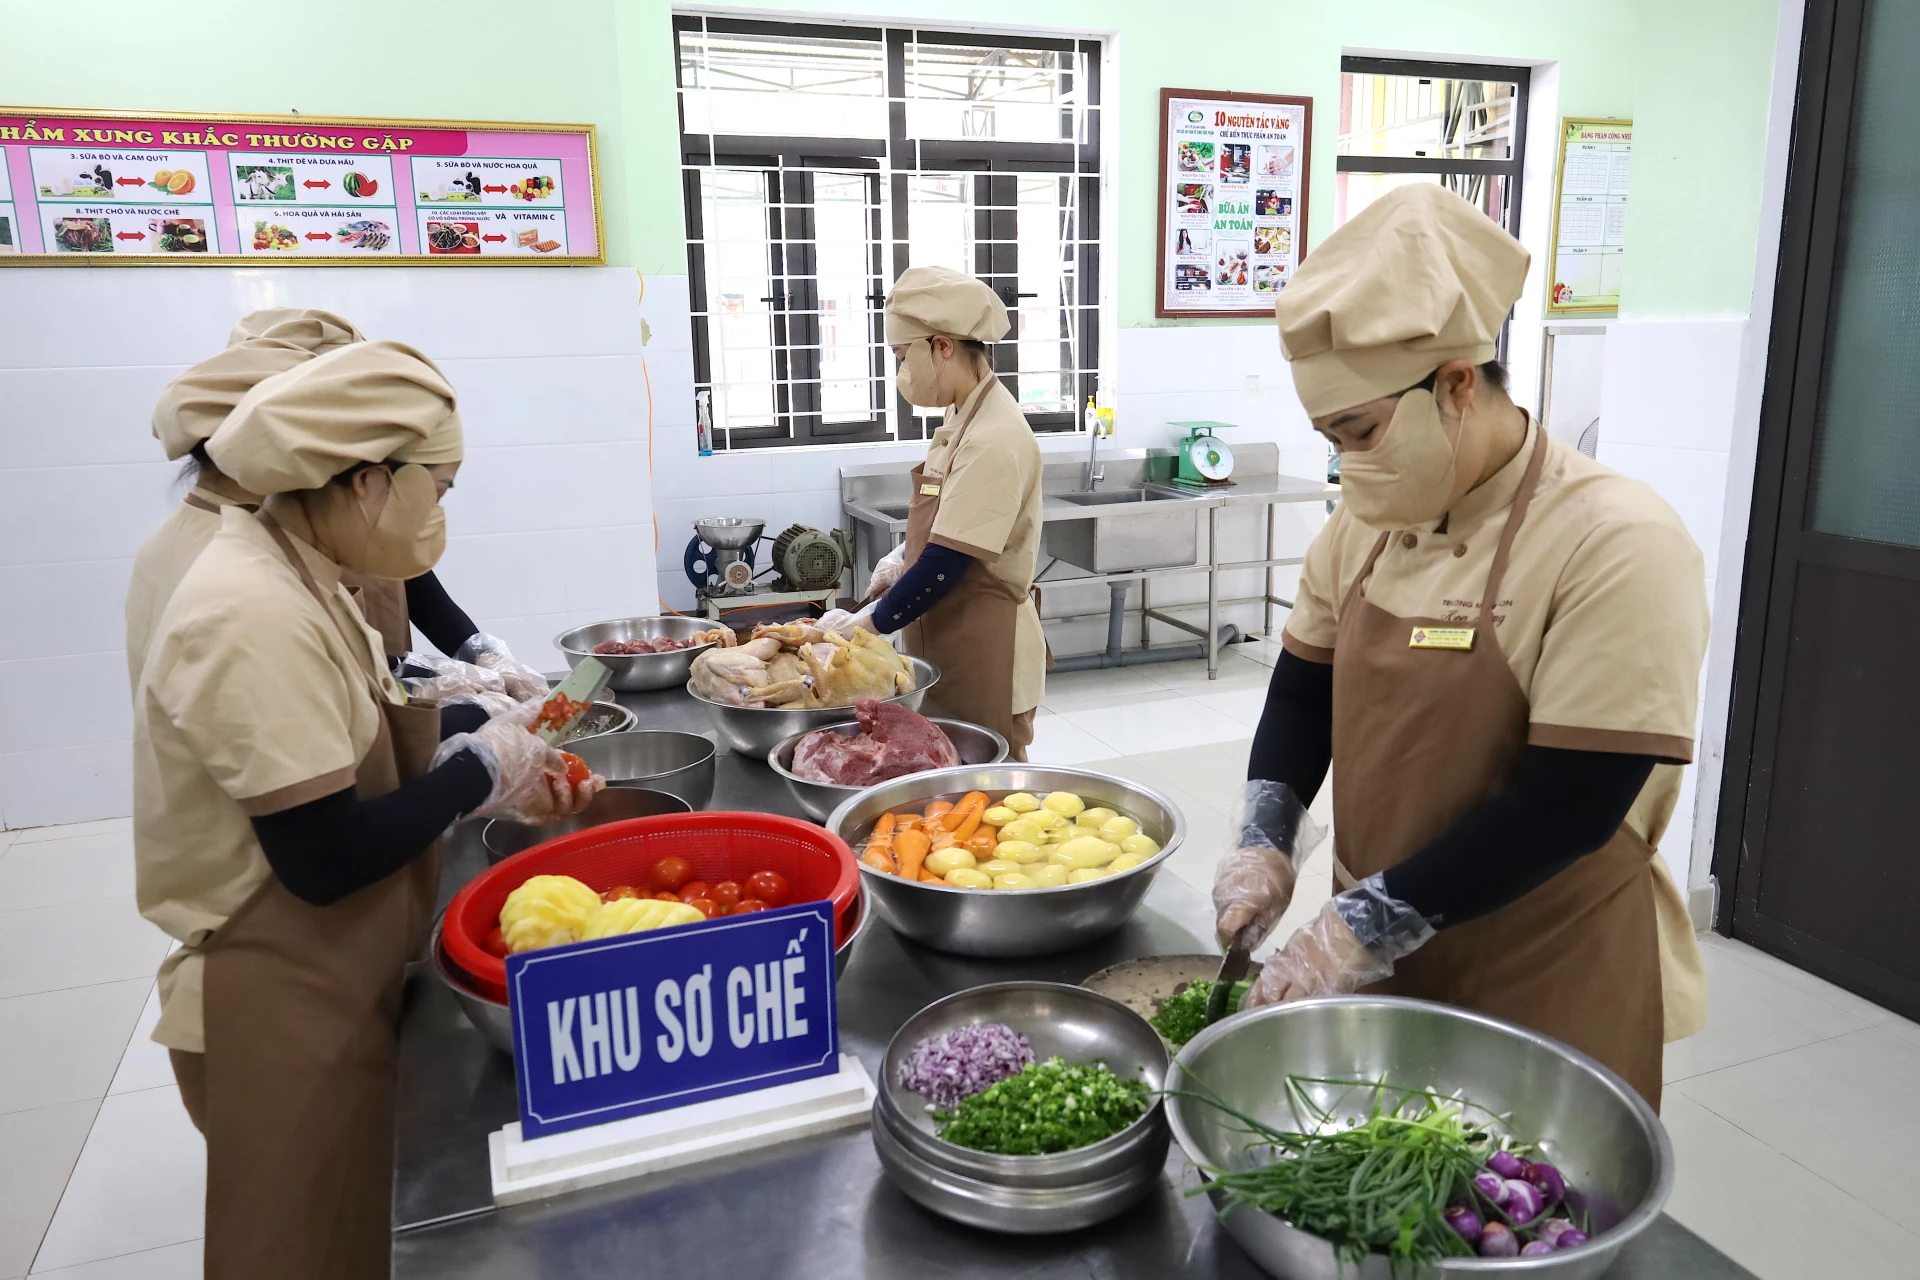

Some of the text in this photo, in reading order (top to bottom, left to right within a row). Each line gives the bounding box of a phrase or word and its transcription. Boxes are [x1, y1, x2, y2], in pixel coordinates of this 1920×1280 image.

[1214, 111, 1226, 127] 10
[1227, 113, 1255, 128] NGUYÊN
[1256, 111, 1269, 129] TẮC
[1270, 115, 1290, 130] VÀNG
[72, 129, 155, 144] XUNG
[161, 126, 239, 146] KHẮC
[245, 132, 355, 150] THƯỜNG
[361, 134, 414, 153] GẶP
[112, 153, 124, 161] VÀ
[146, 154, 169, 162] QUÝT
[483, 161, 504, 169] NƯỚC
[124, 207, 136, 215] VÀ
[1218, 201, 1250, 214] BỮA ĂN
[513, 213, 548, 221] VITAMIN
[1213, 219, 1227, 230] AN
[1228, 217, 1253, 230] TOÀN
[547, 927, 809, 1086] KHU SƠ CHẾ
